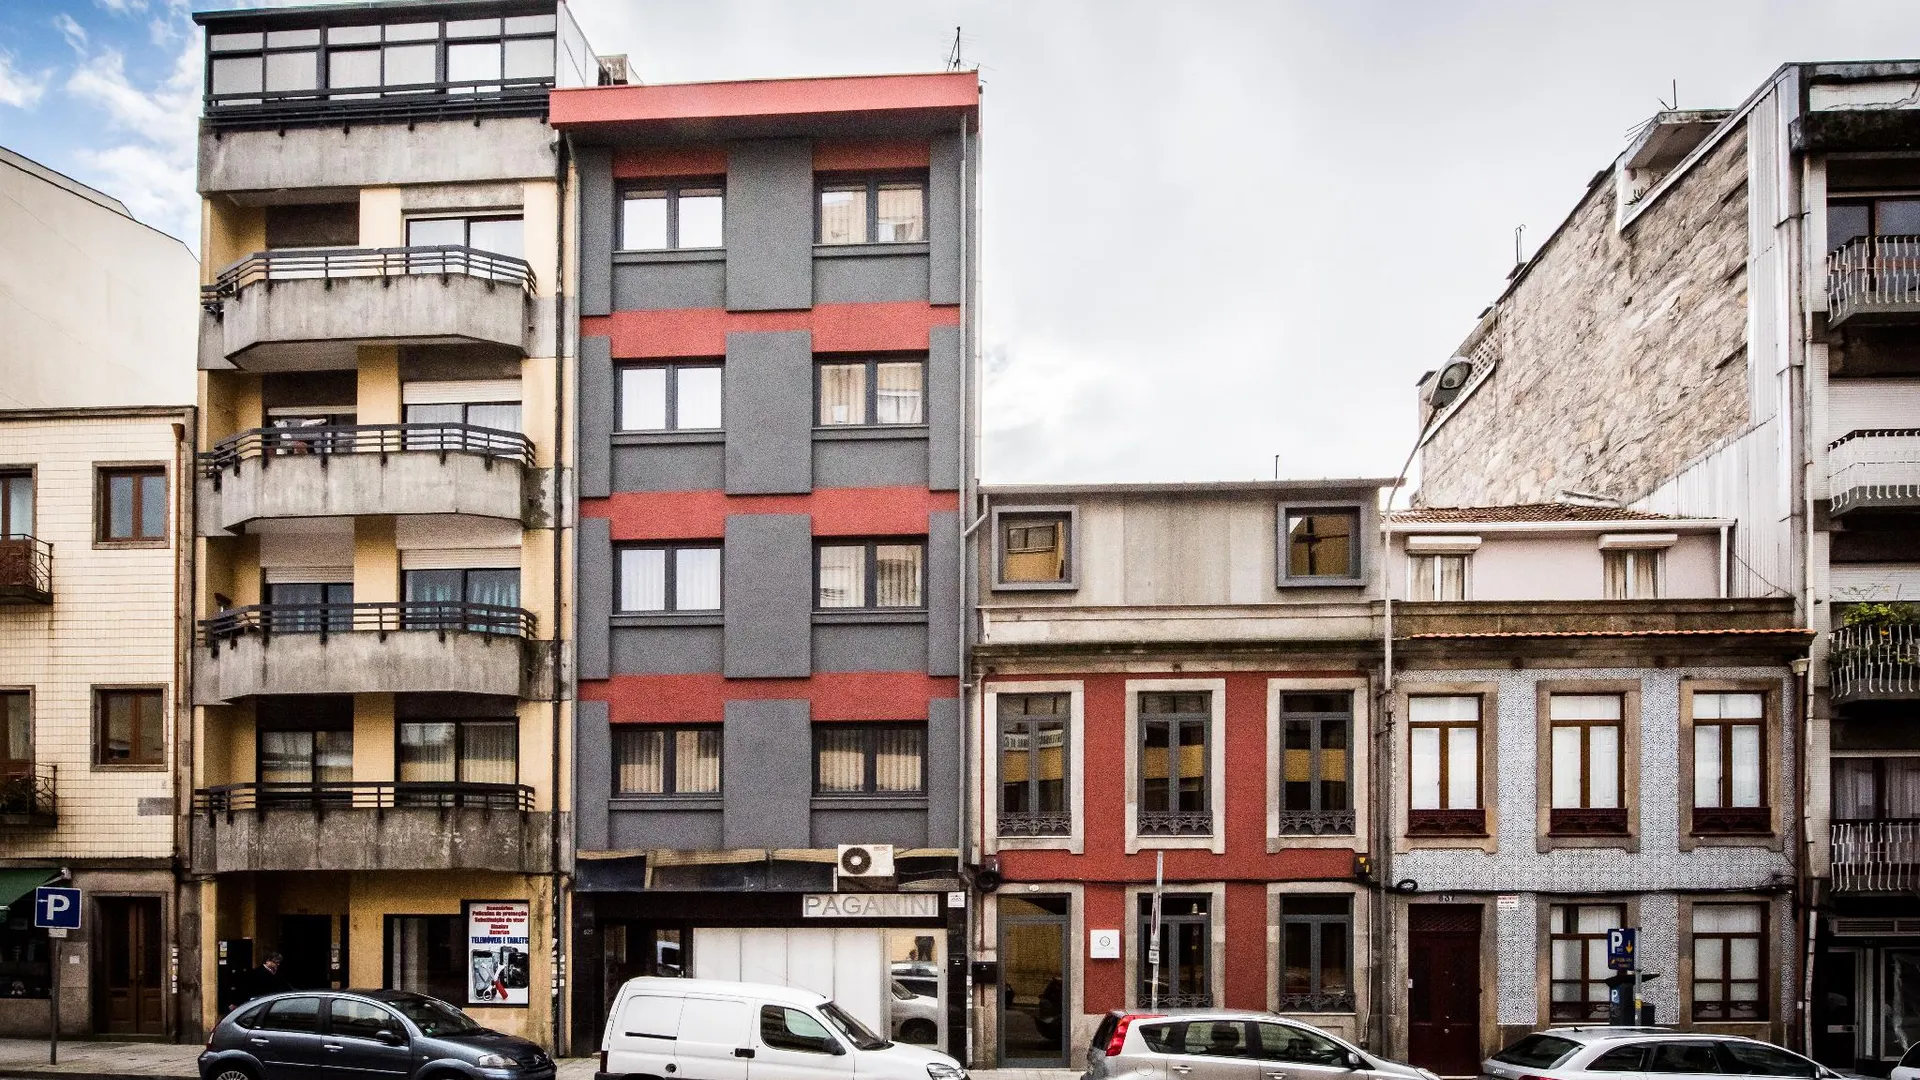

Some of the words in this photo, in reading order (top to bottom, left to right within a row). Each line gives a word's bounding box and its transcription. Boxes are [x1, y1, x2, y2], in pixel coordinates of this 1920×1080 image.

[46, 894, 70, 920] P
[804, 895, 937, 916] PAGANINI
[471, 936, 502, 944] TELEMÓVEIS
[1611, 931, 1623, 954] P
[1611, 989, 1619, 1003] P
